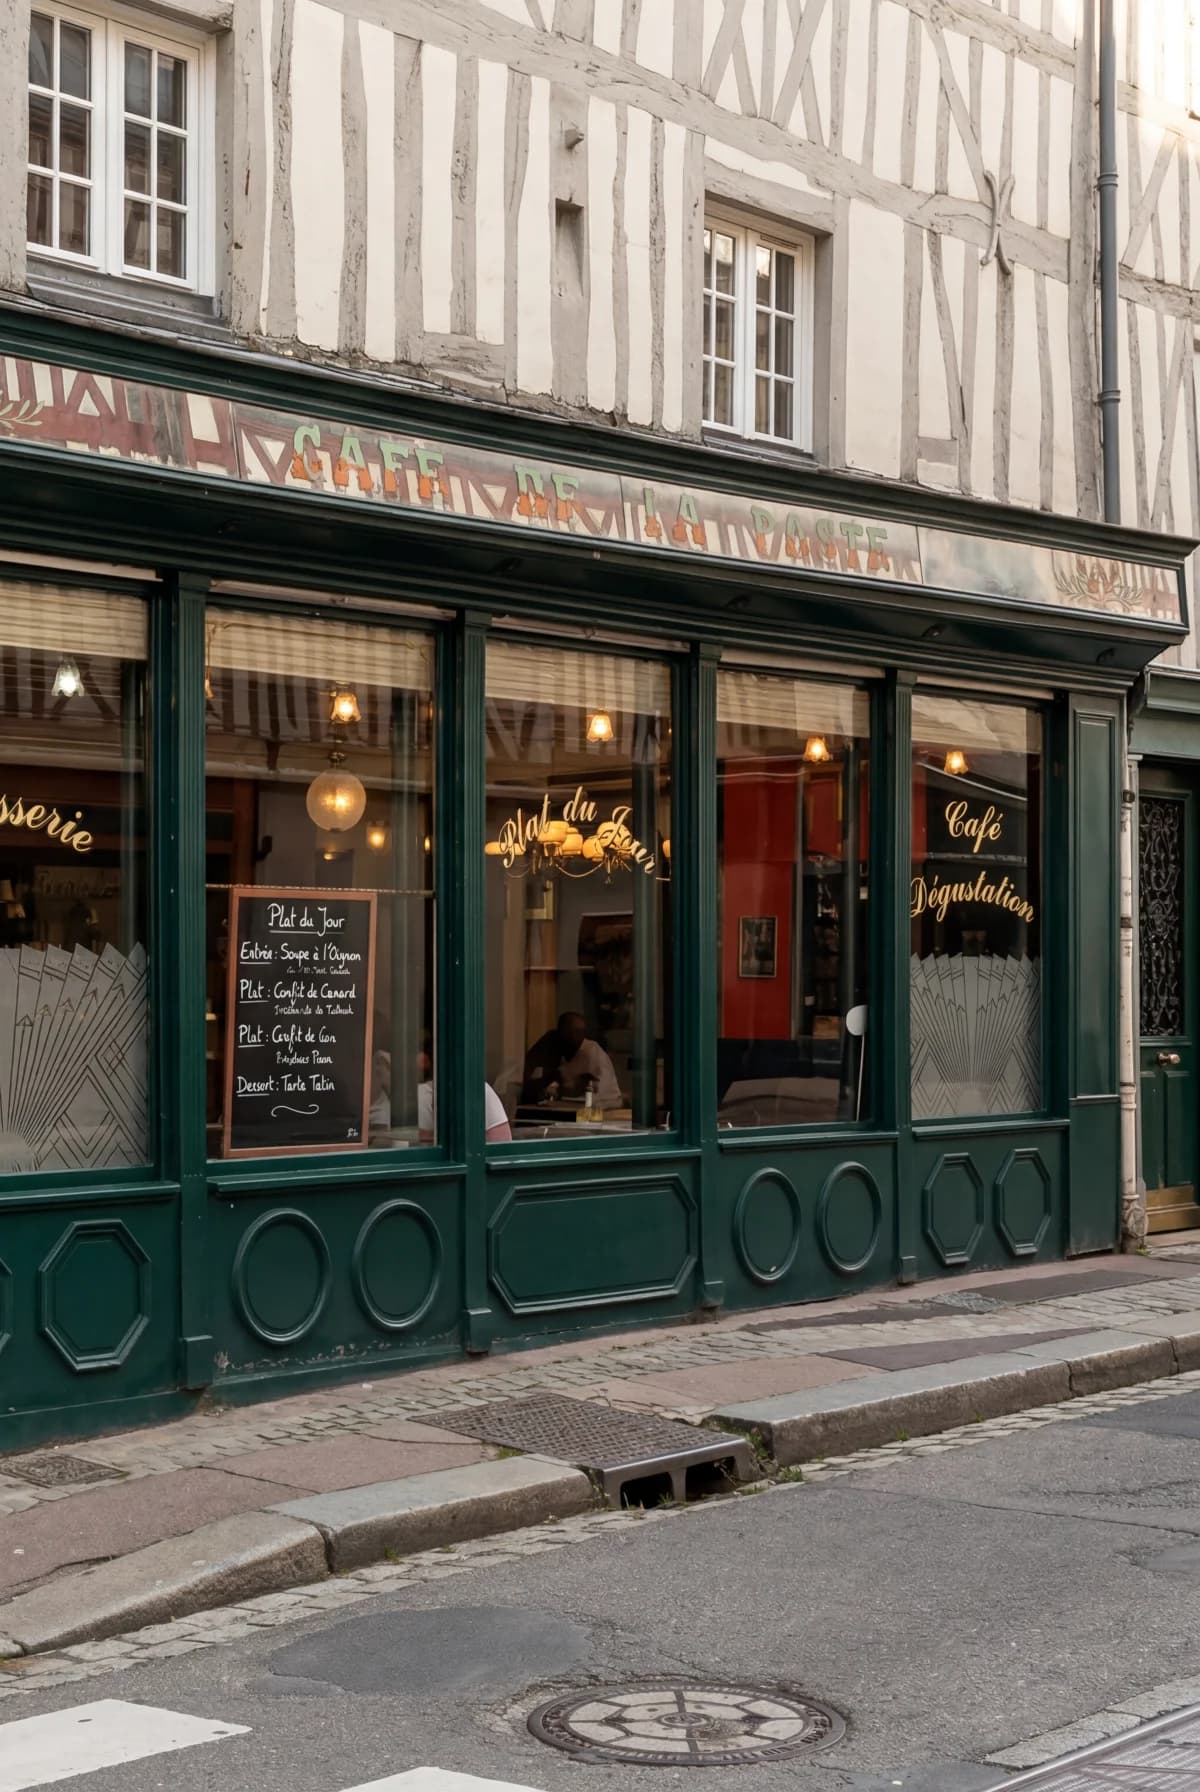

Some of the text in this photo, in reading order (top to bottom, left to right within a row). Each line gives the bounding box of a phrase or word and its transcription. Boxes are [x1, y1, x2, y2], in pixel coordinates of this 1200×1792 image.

[498, 793, 551, 868] Plat
[562, 785, 598, 822] du
[945, 800, 1004, 853] Café
[910, 871, 1035, 923] Dégustation
[267, 903, 345, 936] Plat du Jour
[307, 982, 318, 999] de
[305, 1027, 316, 1043] de
[280, 1074, 306, 1092] Tarte
